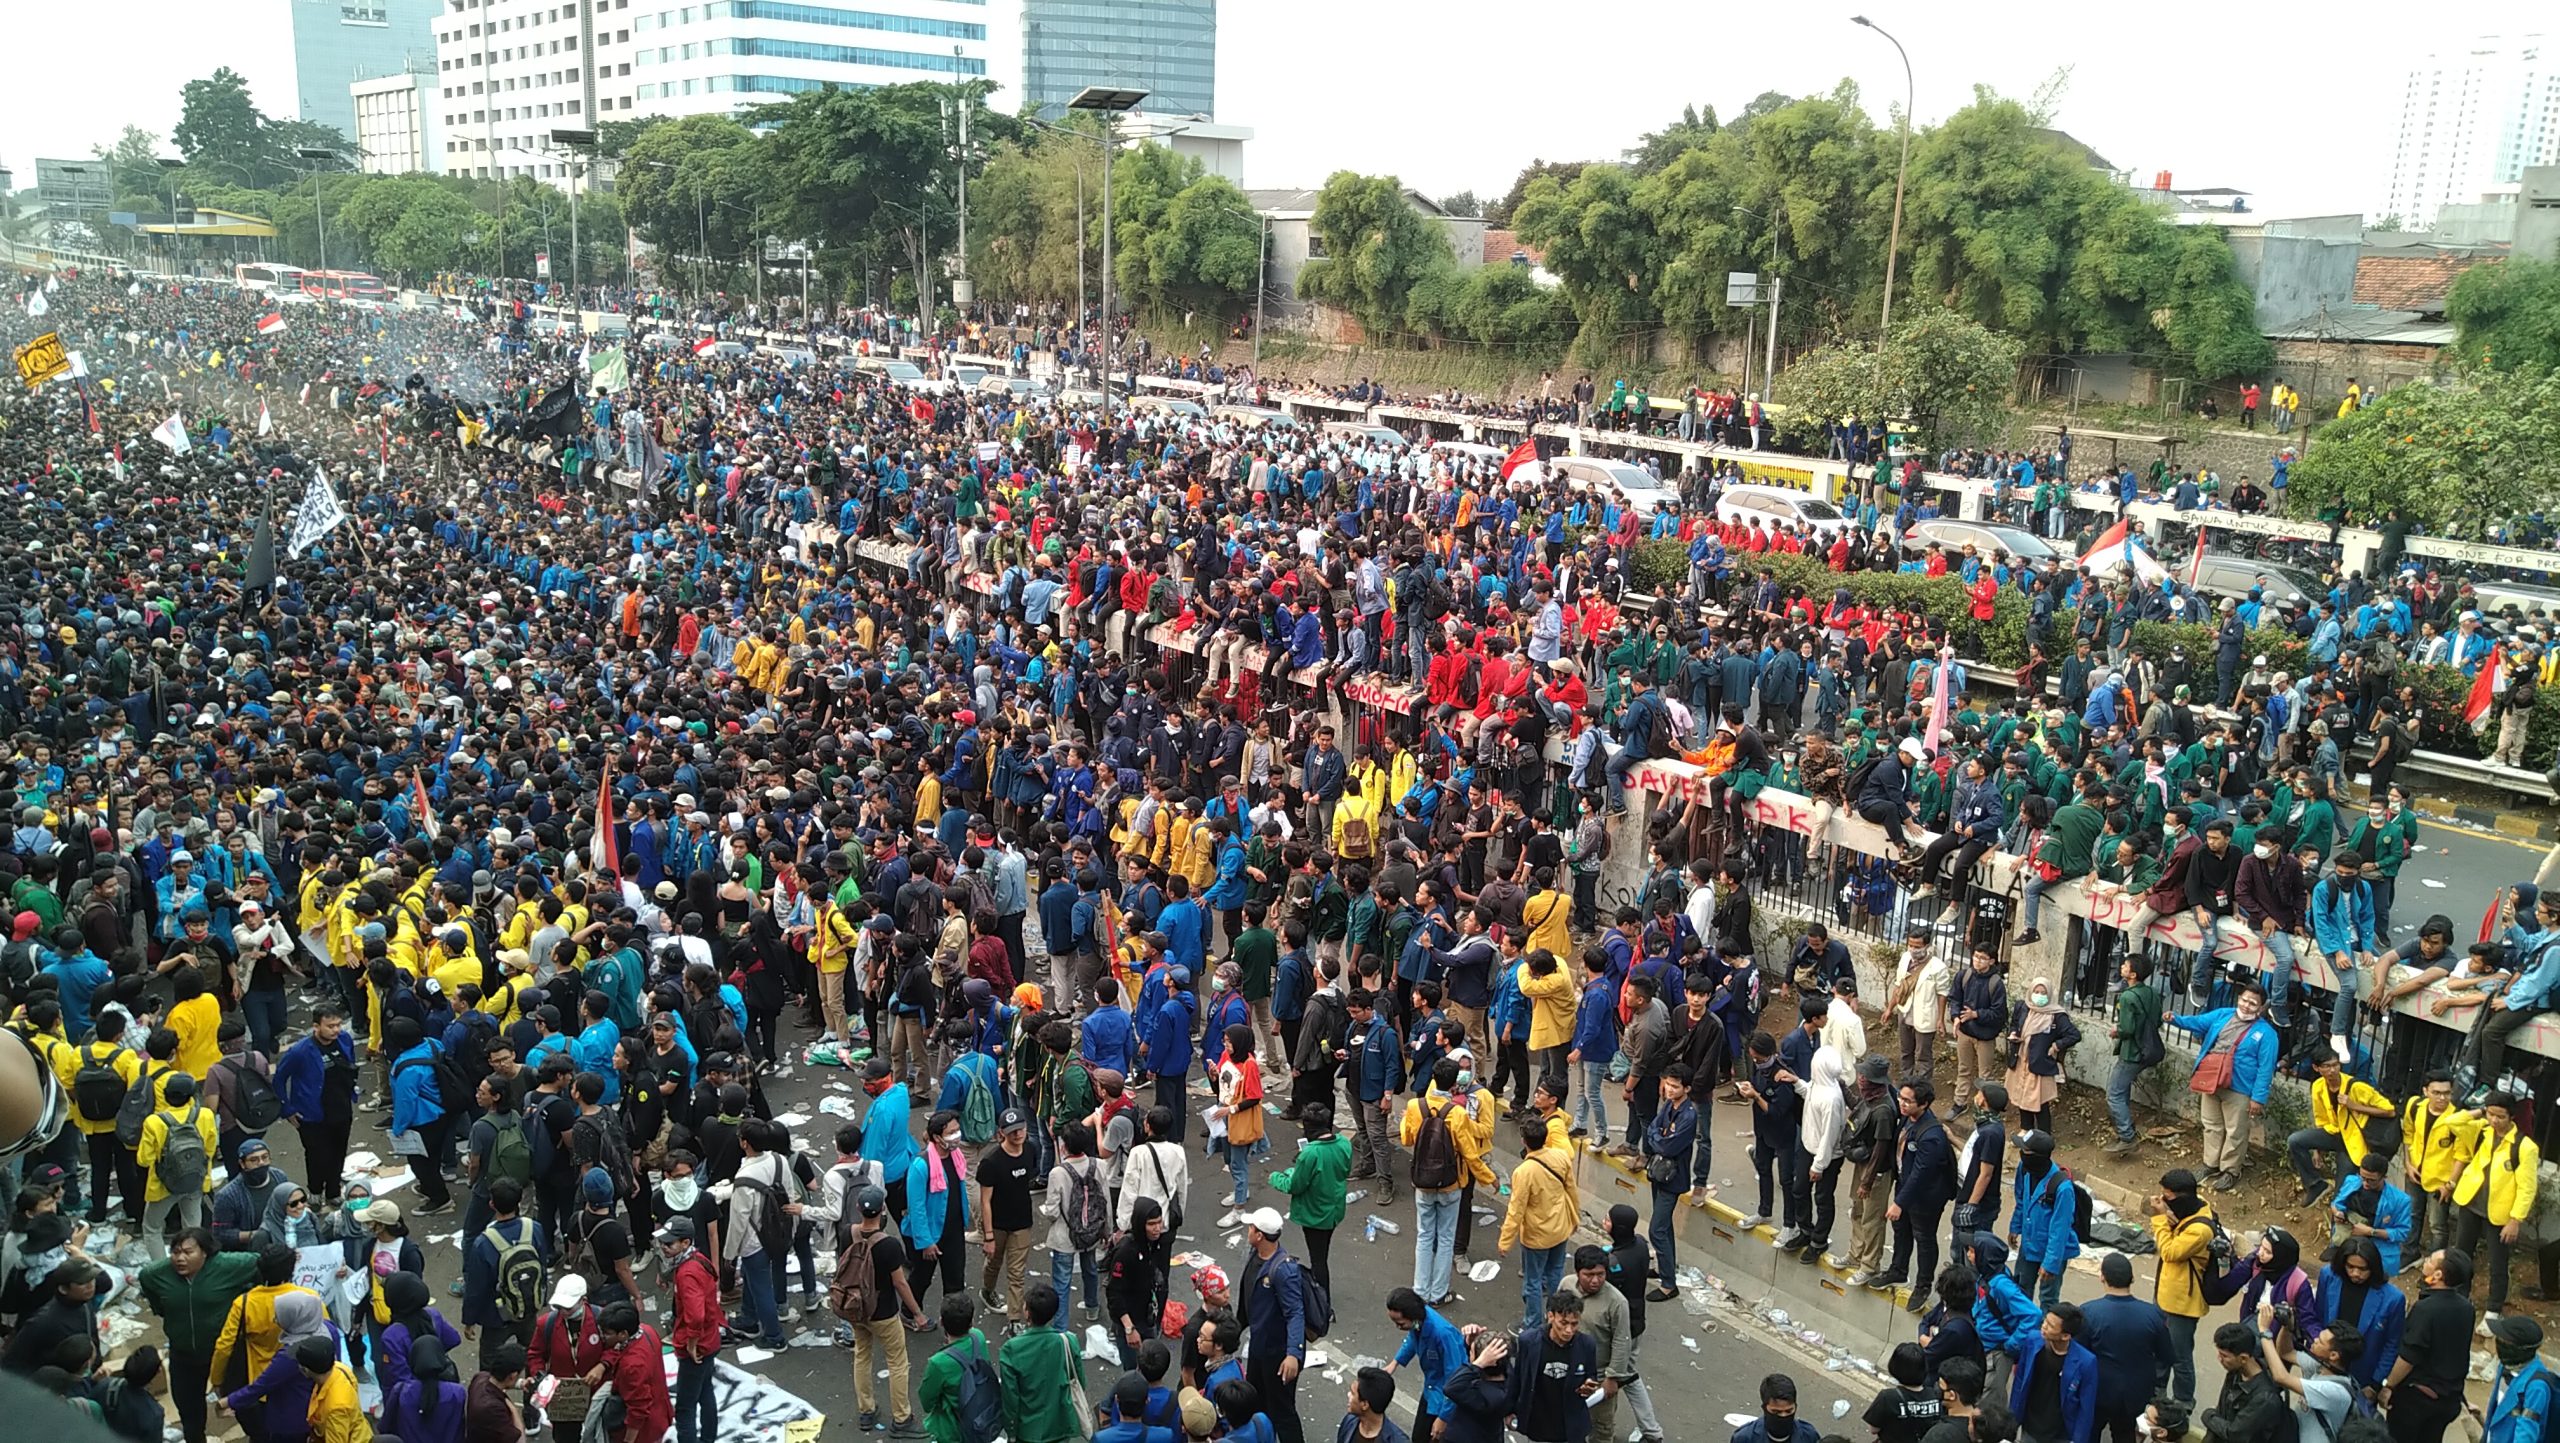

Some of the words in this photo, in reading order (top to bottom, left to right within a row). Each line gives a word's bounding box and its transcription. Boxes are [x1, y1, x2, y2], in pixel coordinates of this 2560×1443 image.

[2180, 511, 2223, 525] GANJA
[2226, 519, 2272, 532] UNTUK
[2277, 526, 2346, 541] RAKYA
[2425, 545, 2447, 556] NO
[2455, 549, 2487, 560] ONE
[2495, 552, 2526, 564] FOR
